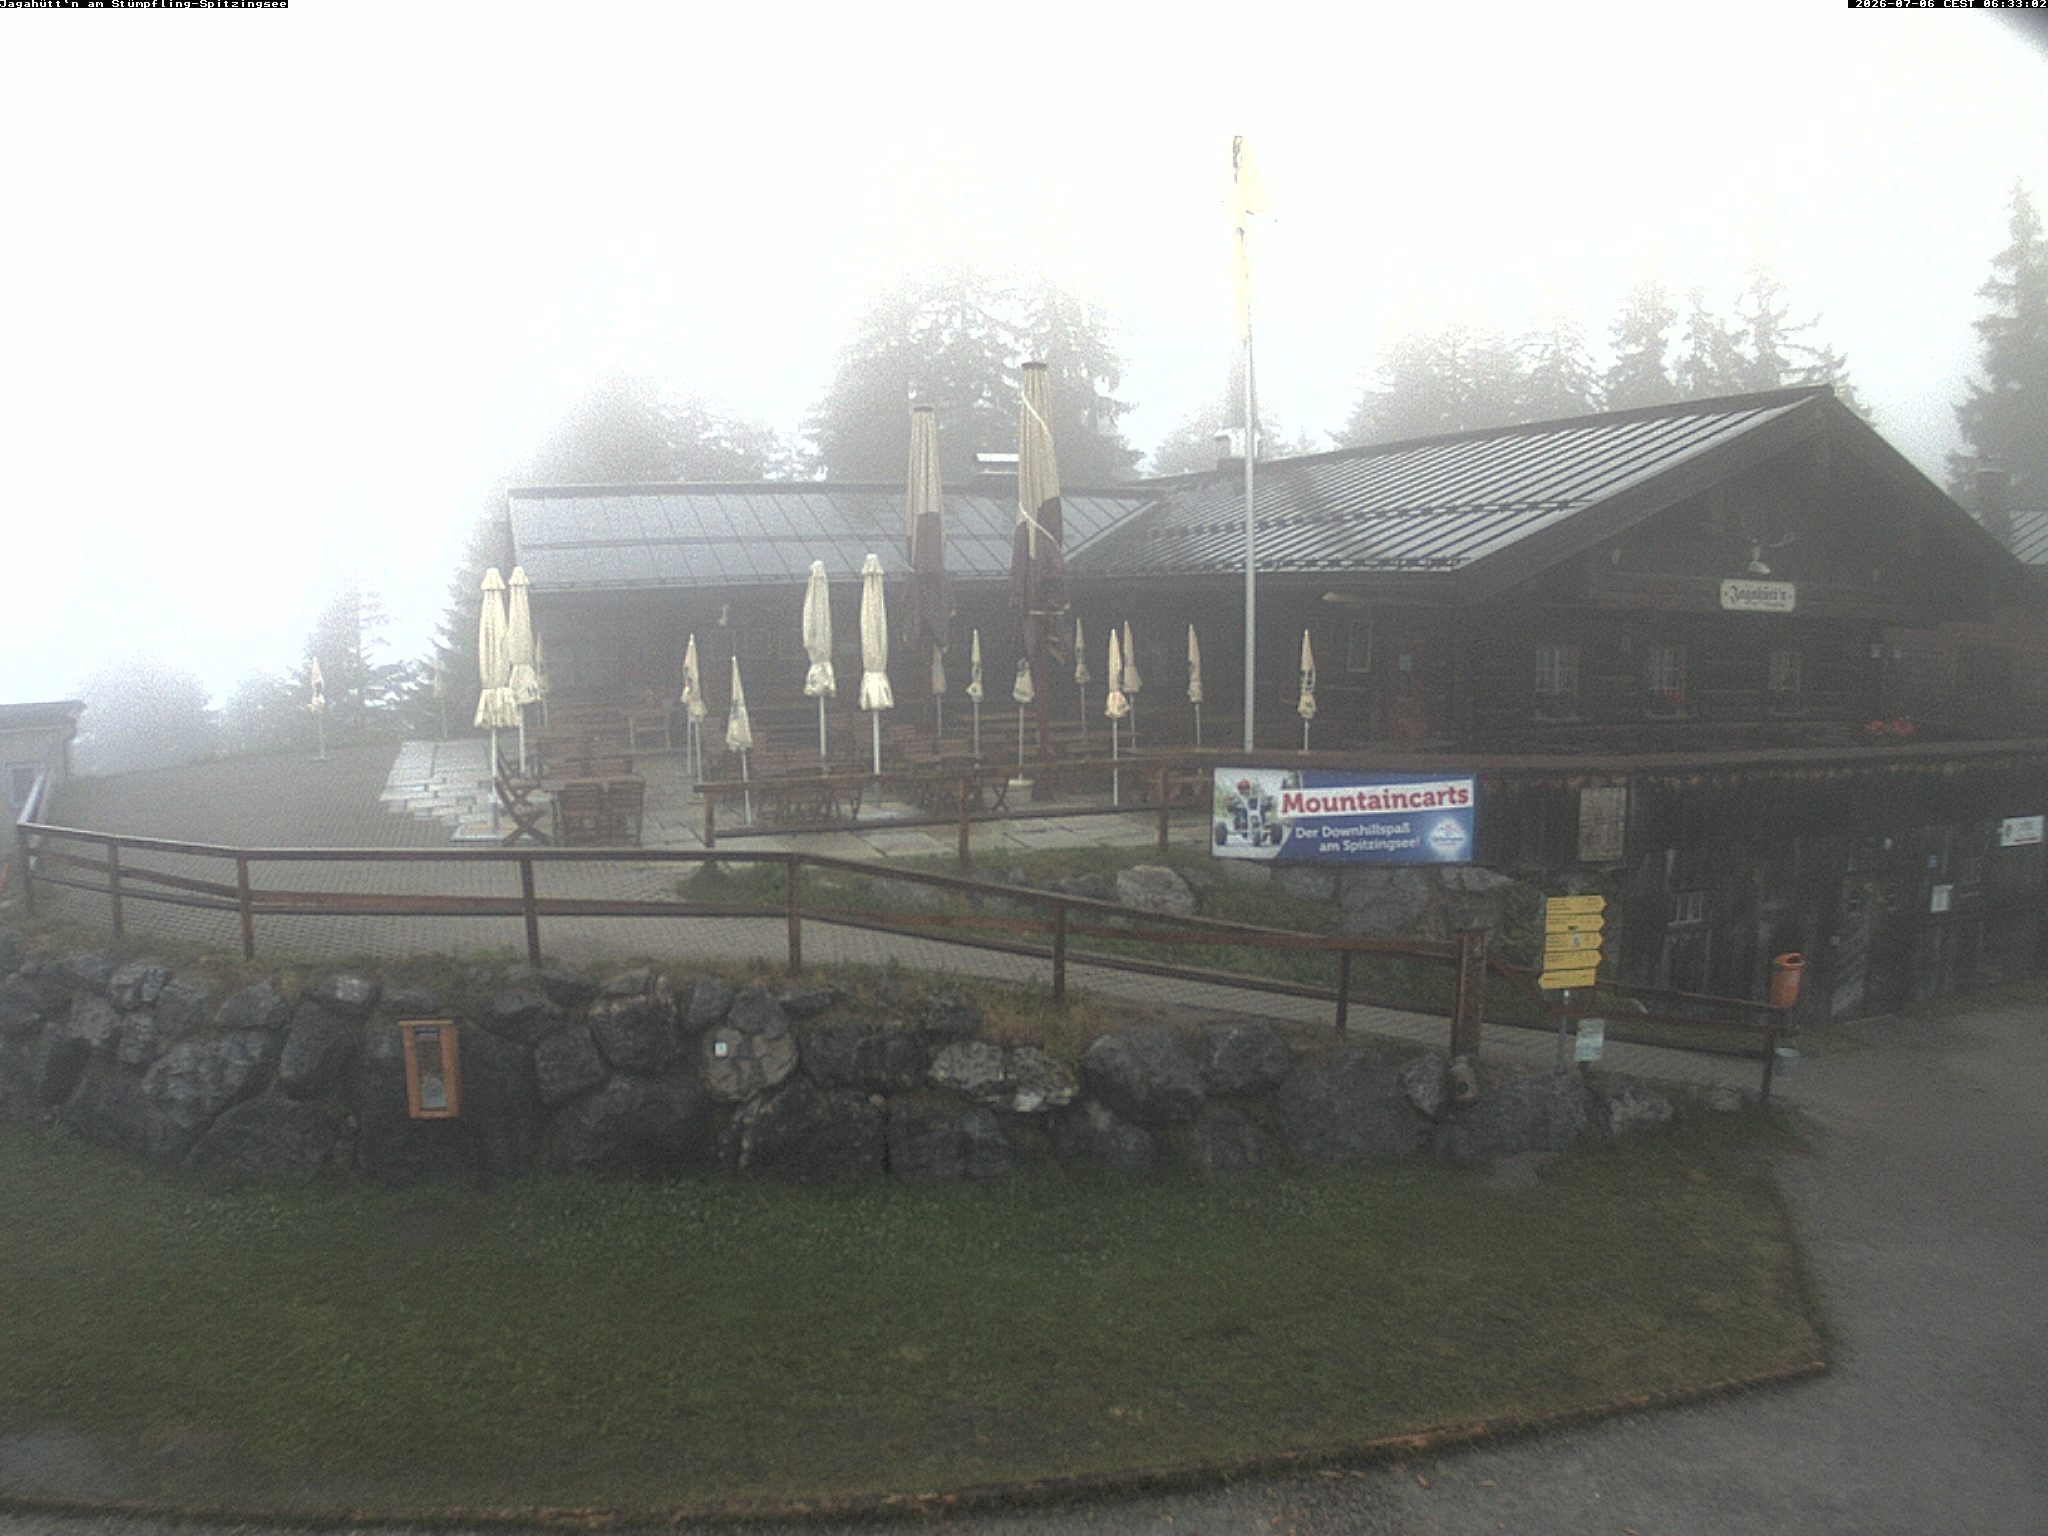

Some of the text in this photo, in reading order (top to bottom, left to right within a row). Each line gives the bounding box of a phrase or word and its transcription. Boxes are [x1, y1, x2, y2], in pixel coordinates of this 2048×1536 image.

[1281, 786, 1470, 814] Mountaincarts
[1295, 822, 1411, 838] Der Downhillspaß
[1319, 841, 1341, 852] am
